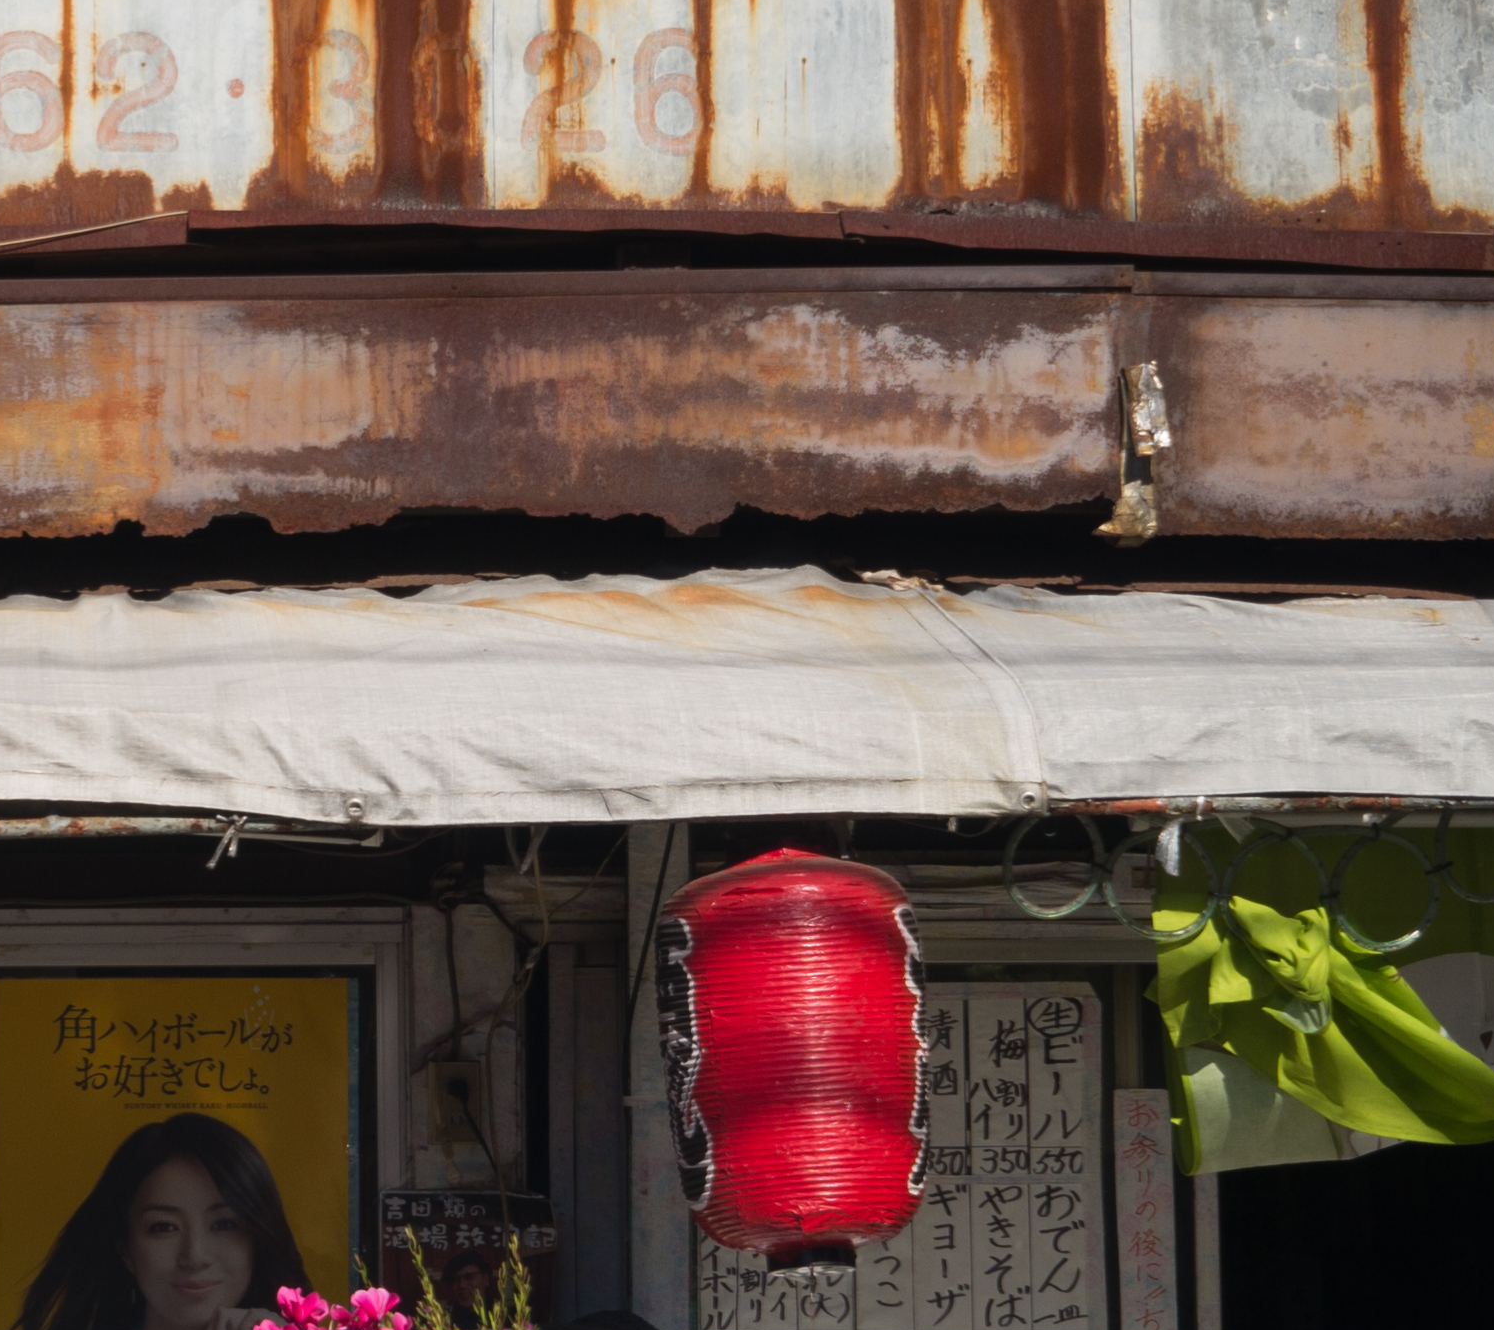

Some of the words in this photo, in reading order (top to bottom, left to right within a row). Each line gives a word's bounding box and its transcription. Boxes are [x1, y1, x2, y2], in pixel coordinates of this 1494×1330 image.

[53, 1004, 293, 1054] 角ハイボールが
[75, 1055, 269, 1098] お好きでしょ。
[1026, 998, 1082, 1137] 生ビール
[979, 1149, 1029, 1172] 350
[1035, 1148, 1082, 1173] 550
[385, 1196, 486, 1219] 吉田類の
[874, 1237, 904, 1308] っこ
[927, 1184, 971, 1324] ギョーザ
[979, 1185, 1030, 1328] やきそば
